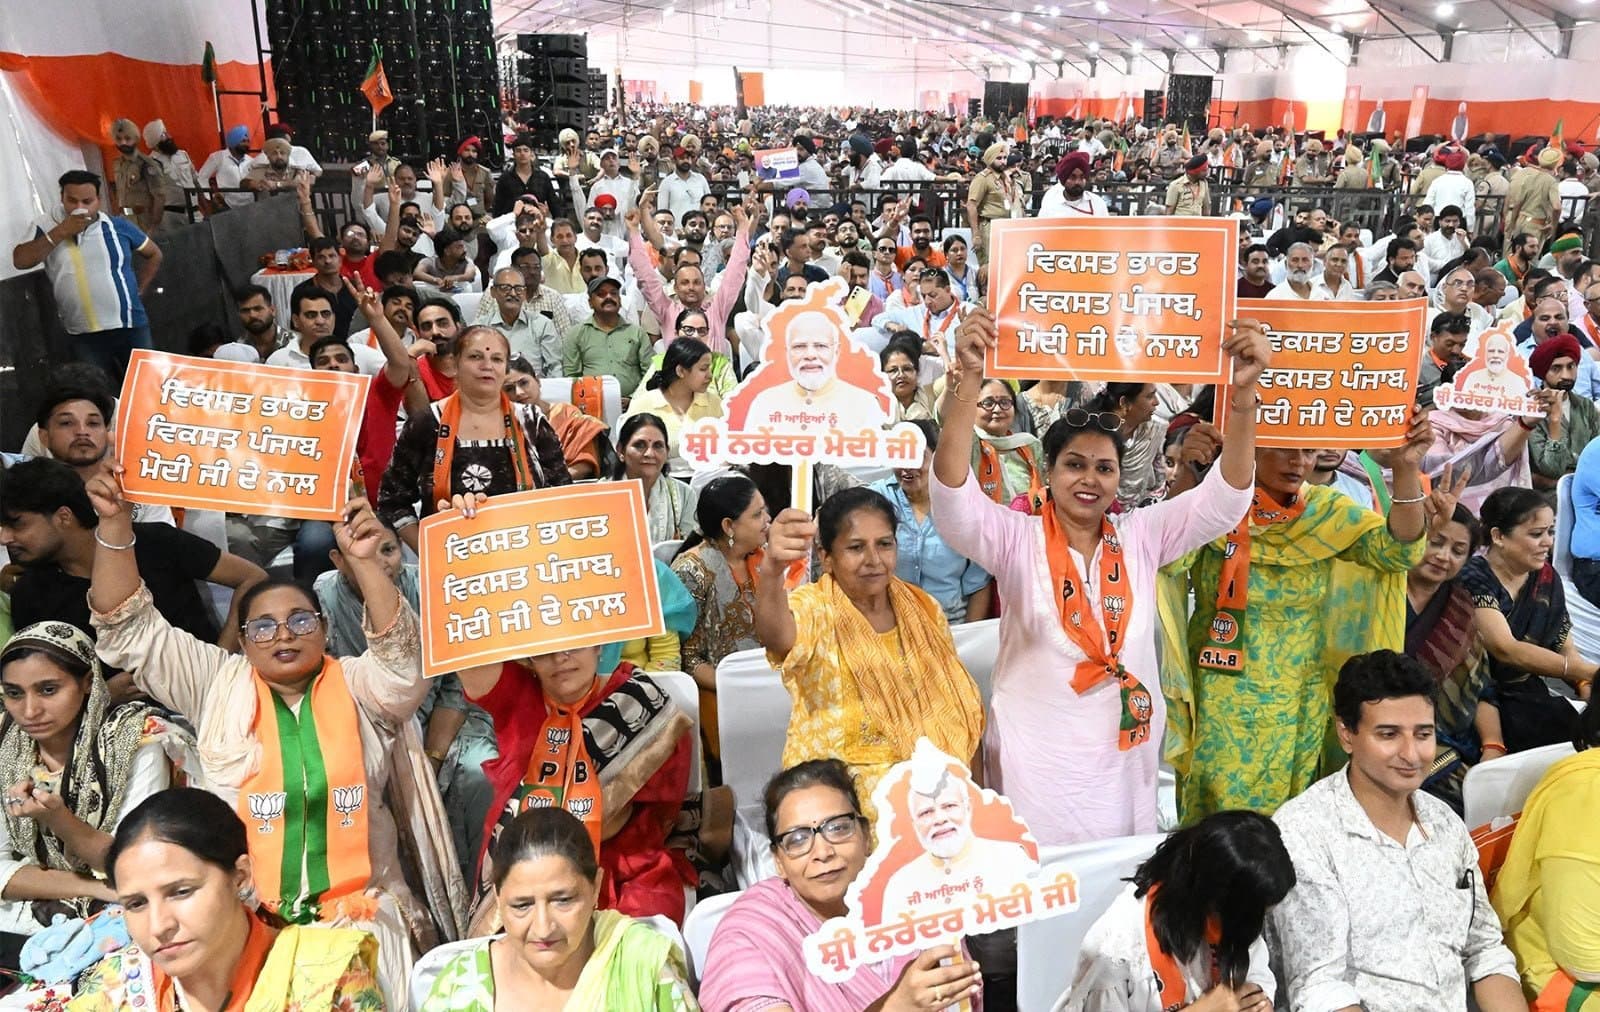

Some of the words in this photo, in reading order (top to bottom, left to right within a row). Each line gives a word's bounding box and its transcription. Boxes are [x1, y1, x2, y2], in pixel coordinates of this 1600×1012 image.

[1026, 242, 1120, 274] ਵਿਕਸਤ
[1126, 251, 1200, 275] ਭਾਰਤ
[1018, 282, 1113, 314] ਵਿਕਸਤ
[1119, 284, 1203, 320] ਪੰਜਾਬ,
[1017, 323, 1068, 355] ਮੋਦੀ
[1076, 324, 1108, 356] ਜੀ
[1145, 334, 1202, 358] ਨਾਲ
[1350, 331, 1410, 354] ਭਾਰਤ
[1340, 362, 1409, 391] ਪੰਜਾਬ,
[160, 378, 255, 414] ਵਿਕਸਤ
[260, 391, 328, 422] ਭਾਰਤ
[1298, 398, 1328, 426] ਜੀ
[1334, 398, 1355, 426] ਦੇ
[1360, 404, 1407, 426] ਨਾਲ
[438, 424, 450, 438] B
[769, 411, 782, 424] ਜੀ
[146, 413, 242, 451] ਵਿਕਸਤ
[248, 425, 322, 461] ਪੰਜਾਬ,
[727, 426, 816, 456] ਨਰੇਂਦਰ
[824, 427, 878, 458] ਮੋਦੀ
[886, 428, 918, 459] ਜੀ
[140, 449, 192, 483] ਮੋਦੀ
[198, 458, 232, 487] ਜੀ
[237, 459, 260, 489] ਦੇ
[266, 471, 320, 496] ਨਾਲ
[445, 525, 531, 563] ਵਿਕਸਤ
[536, 514, 610, 545] ਭਾਰਤ
[443, 565, 529, 604] ਵਿਕਸਤ
[535, 552, 622, 584] ਪੰਜਾਬ,
[1108, 562, 1120, 582] J
[446, 607, 491, 645] ਮੋਦੀ
[498, 600, 532, 634] ਜੀ
[538, 594, 562, 626] ਦੇ
[568, 591, 628, 622] ਨਾਲ
[538, 762, 559, 783] P
[575, 761, 588, 783] B
[864, 906, 965, 953] ਨਰੇਂਦਰ
[972, 882, 1033, 924] ਮੋਦੀ
[1041, 871, 1077, 909] ਜੀ
[907, 890, 922, 906] ਜੀ
